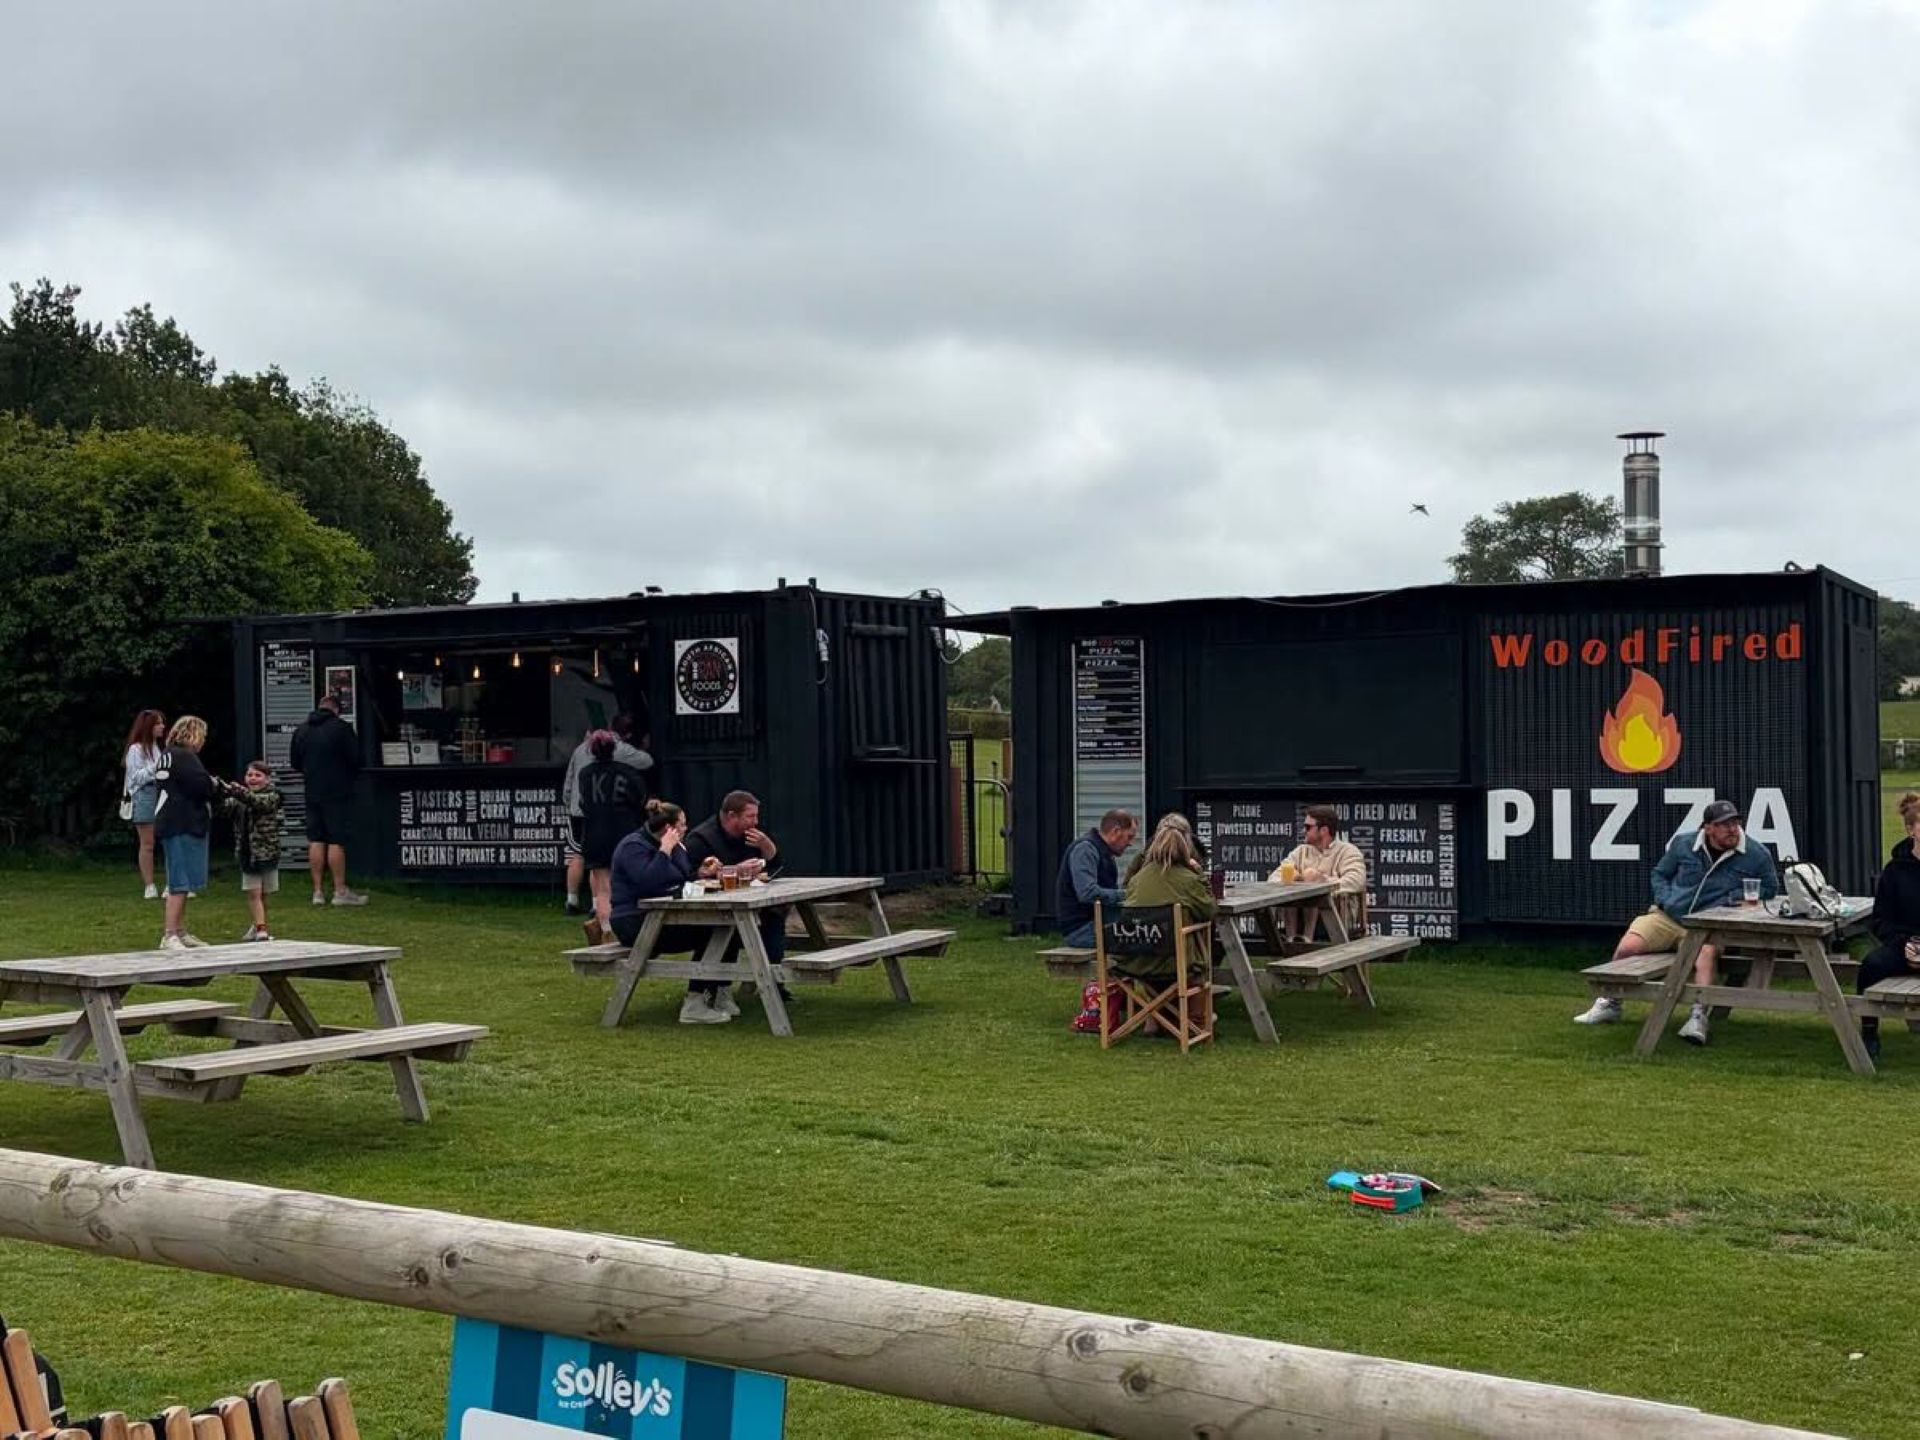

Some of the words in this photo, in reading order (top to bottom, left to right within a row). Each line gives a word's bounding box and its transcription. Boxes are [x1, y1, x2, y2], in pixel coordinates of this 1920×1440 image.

[416, 790, 463, 808] TASTERS
[515, 790, 556, 802] CHURROS
[400, 791, 413, 824] PAELLA
[480, 804, 510, 820] CURRY
[513, 806, 546, 824] WRAPS
[1197, 802, 1212, 817] UP
[1355, 804, 1385, 821] FIRED
[1389, 803, 1417, 821] OVEN
[420, 811, 458, 824] SAMOSAS
[1487, 787, 1800, 861] PIZZA
[401, 828, 443, 840] CHARCOAL
[446, 826, 473, 840] GRILL
[477, 823, 509, 840] VEGAN
[1379, 828, 1427, 843] FRESHLY
[402, 845, 455, 865] CATERING
[499, 848, 506, 862] &
[1221, 845, 1241, 863] CPT
[1244, 845, 1285, 863] GATSBY
[1379, 849, 1434, 864] PREPARED
[1439, 834, 1454, 889] STRETCHED
[1381, 873, 1435, 887] MARGHERITA
[1387, 891, 1453, 908] MOZZARELLA
[1413, 914, 1452, 924] PAN
[1413, 925, 1452, 938] FOODS
